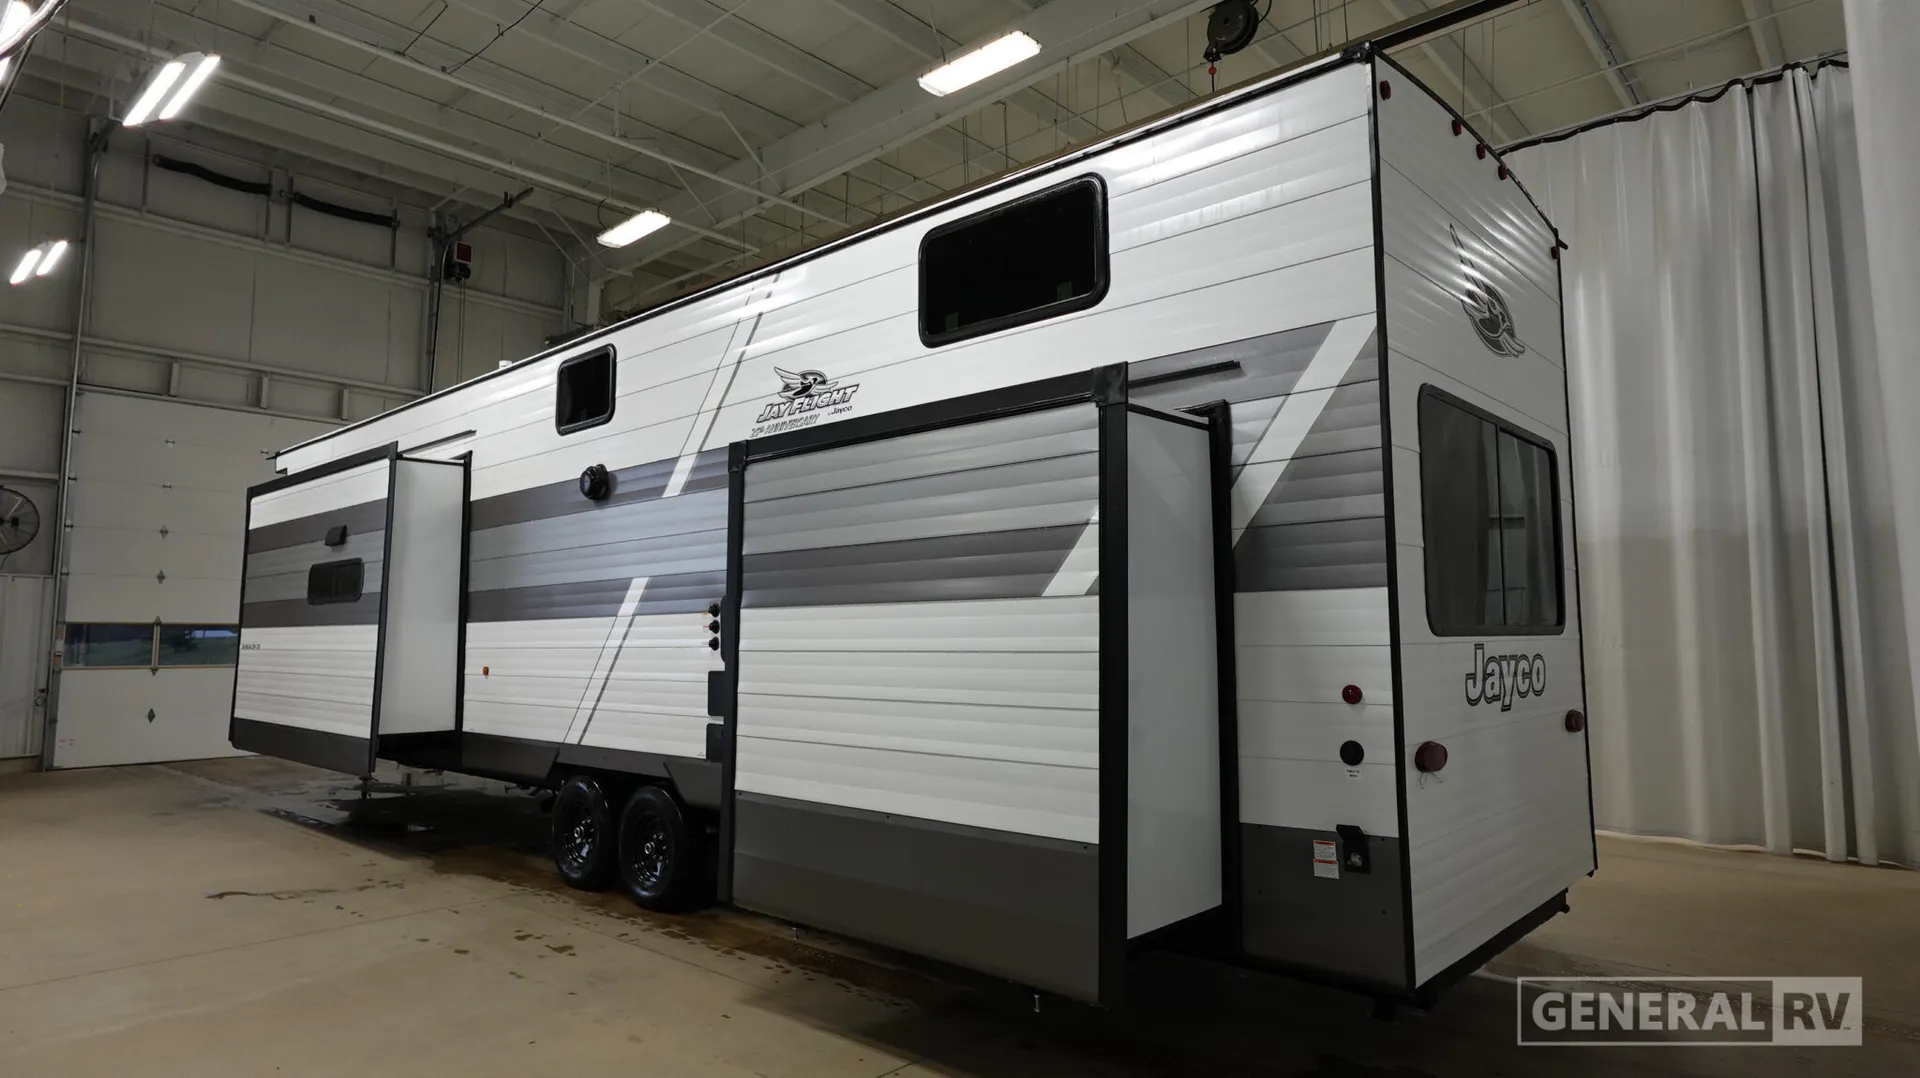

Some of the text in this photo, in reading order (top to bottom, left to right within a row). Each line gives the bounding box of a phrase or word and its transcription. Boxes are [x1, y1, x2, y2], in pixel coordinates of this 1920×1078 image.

[756, 383, 860, 423] JAY FLIGHT
[831, 405, 853, 415] Jayco
[1465, 643, 1546, 712] Jayco
